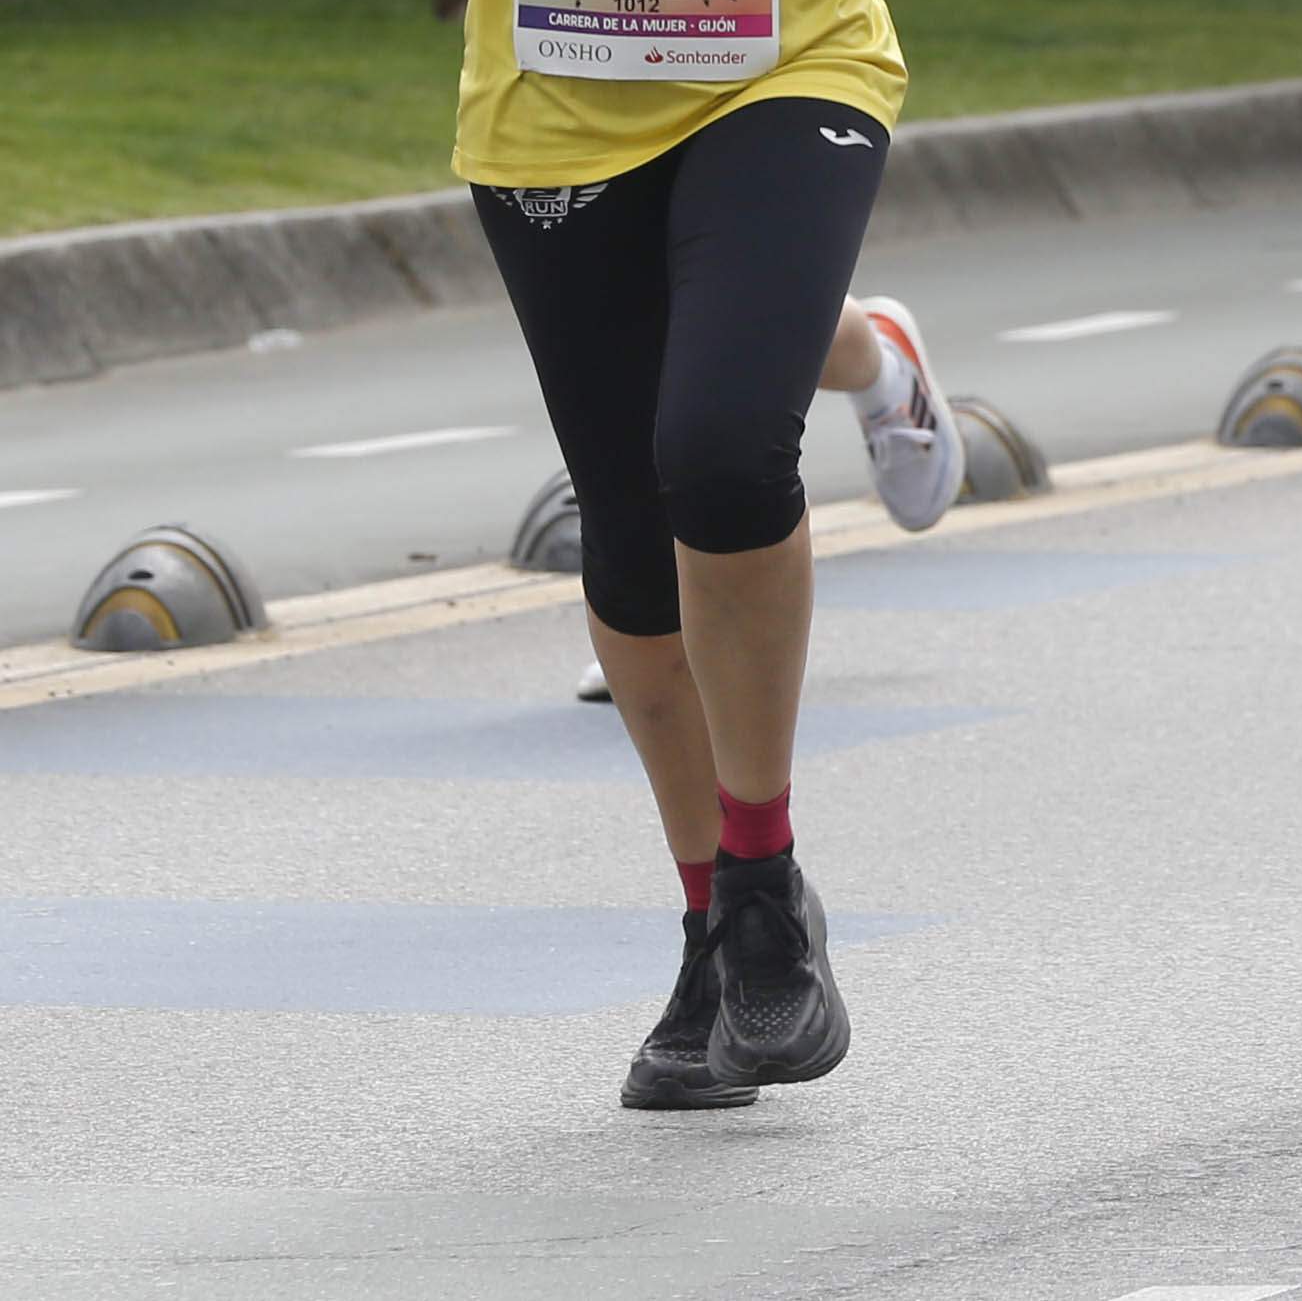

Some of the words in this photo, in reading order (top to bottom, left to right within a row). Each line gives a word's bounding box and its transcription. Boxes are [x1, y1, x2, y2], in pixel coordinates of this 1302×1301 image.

[548, 12, 600, 30] CARRERA
[603, 17, 619, 31] DE
[622, 19, 639, 32] LA
[642, 19, 687, 32] MUJER
[698, 15, 736, 33] GIJÓN
[538, 40, 612, 63] OYSHO
[666, 50, 747, 65] Santander
[525, 201, 564, 214] RUN
